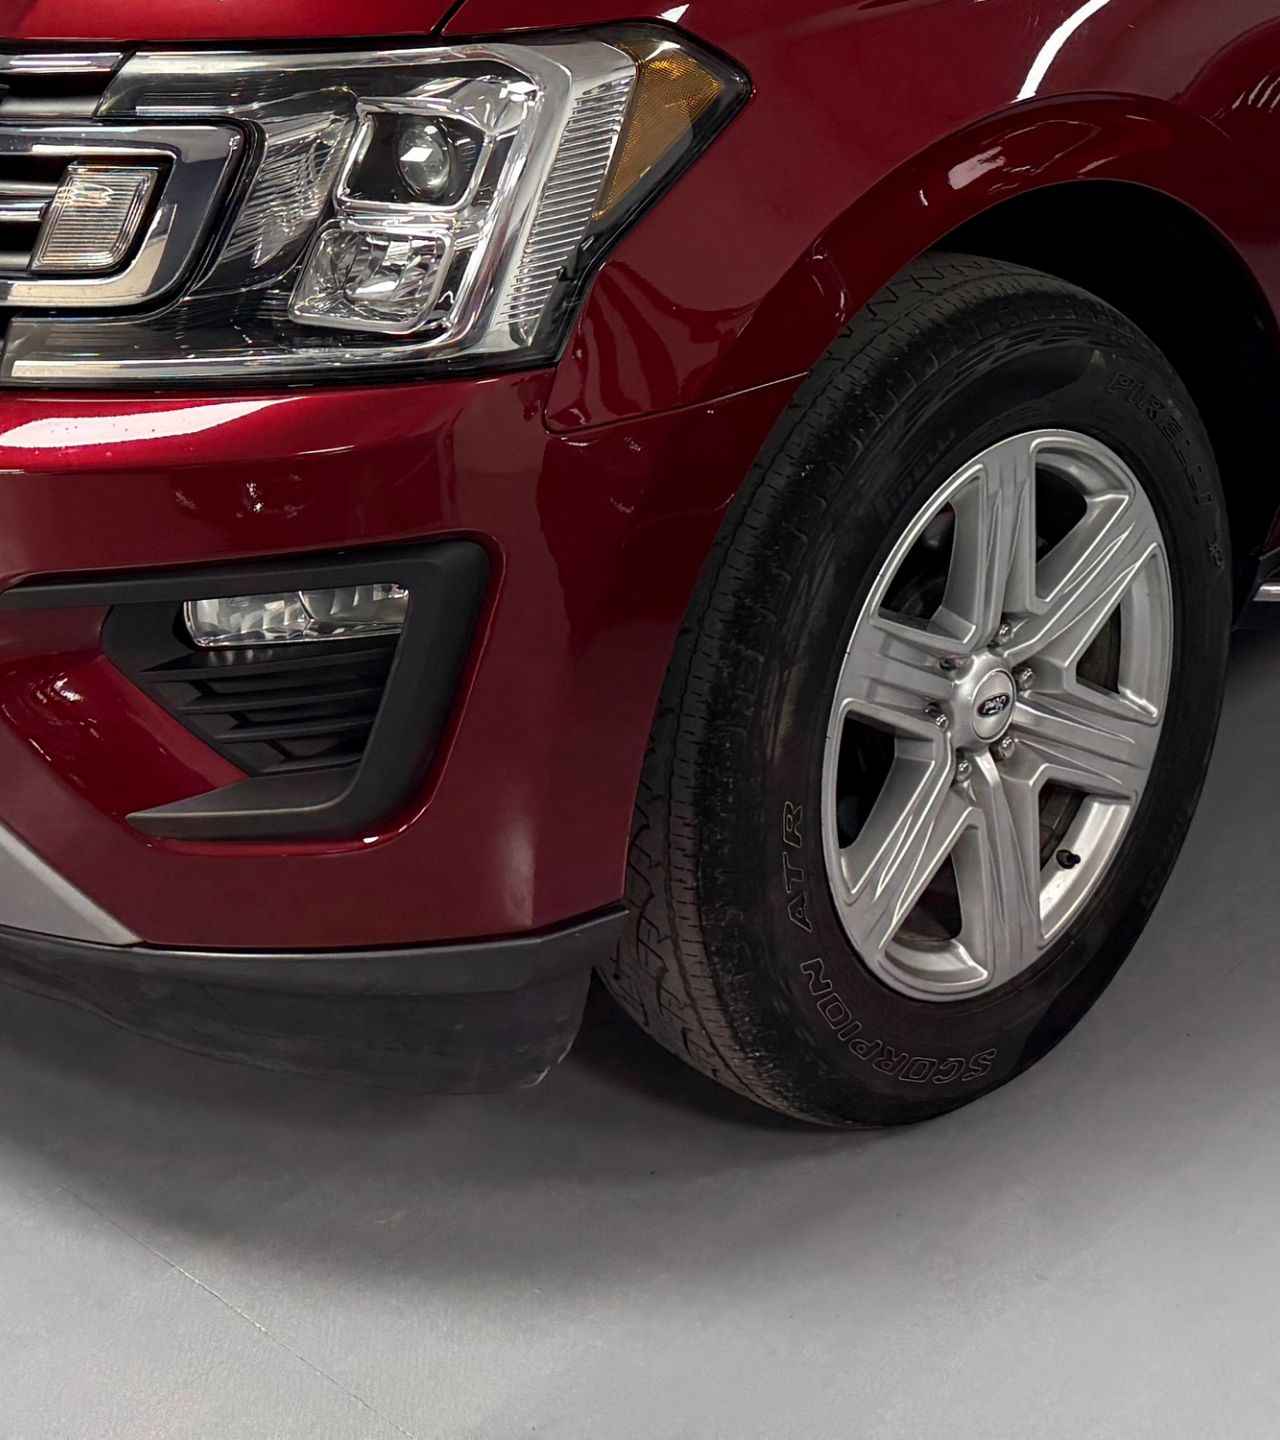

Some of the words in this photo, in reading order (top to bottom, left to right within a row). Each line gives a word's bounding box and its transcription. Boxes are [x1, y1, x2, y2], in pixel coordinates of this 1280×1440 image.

[1107, 371, 1213, 506] PIRELLI
[782, 800, 813, 933] ATR
[800, 958, 997, 1084] SCORPION
